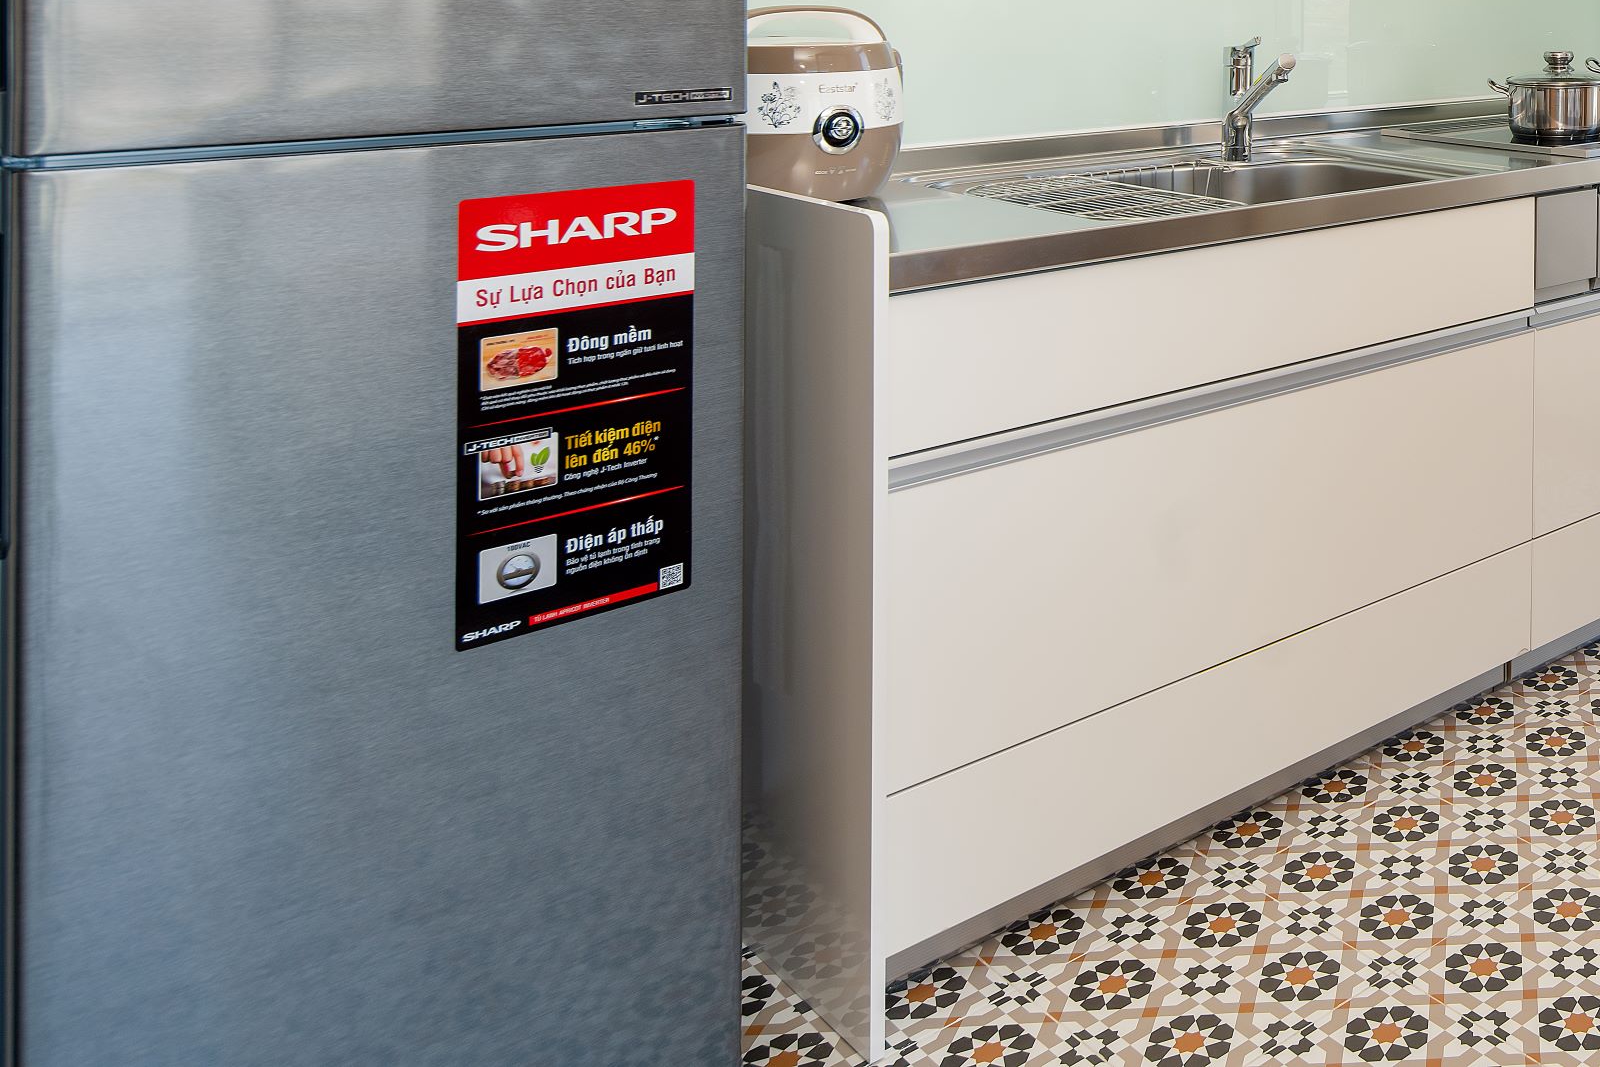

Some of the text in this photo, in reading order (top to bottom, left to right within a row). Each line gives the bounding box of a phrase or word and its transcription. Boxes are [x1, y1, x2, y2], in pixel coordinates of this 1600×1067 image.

[474, 207, 677, 252] SHARP
[476, 267, 676, 309] Sự Lựa Chọn của Bạn
[566, 325, 652, 353] Đông mềm
[564, 430, 593, 450] Tiết
[595, 427, 630, 445] kiệm
[632, 420, 662, 437] điện
[565, 454, 588, 469] lên
[592, 443, 619, 463] đến
[565, 515, 664, 553] Điện áp thấp
[461, 620, 522, 642] SHARP
